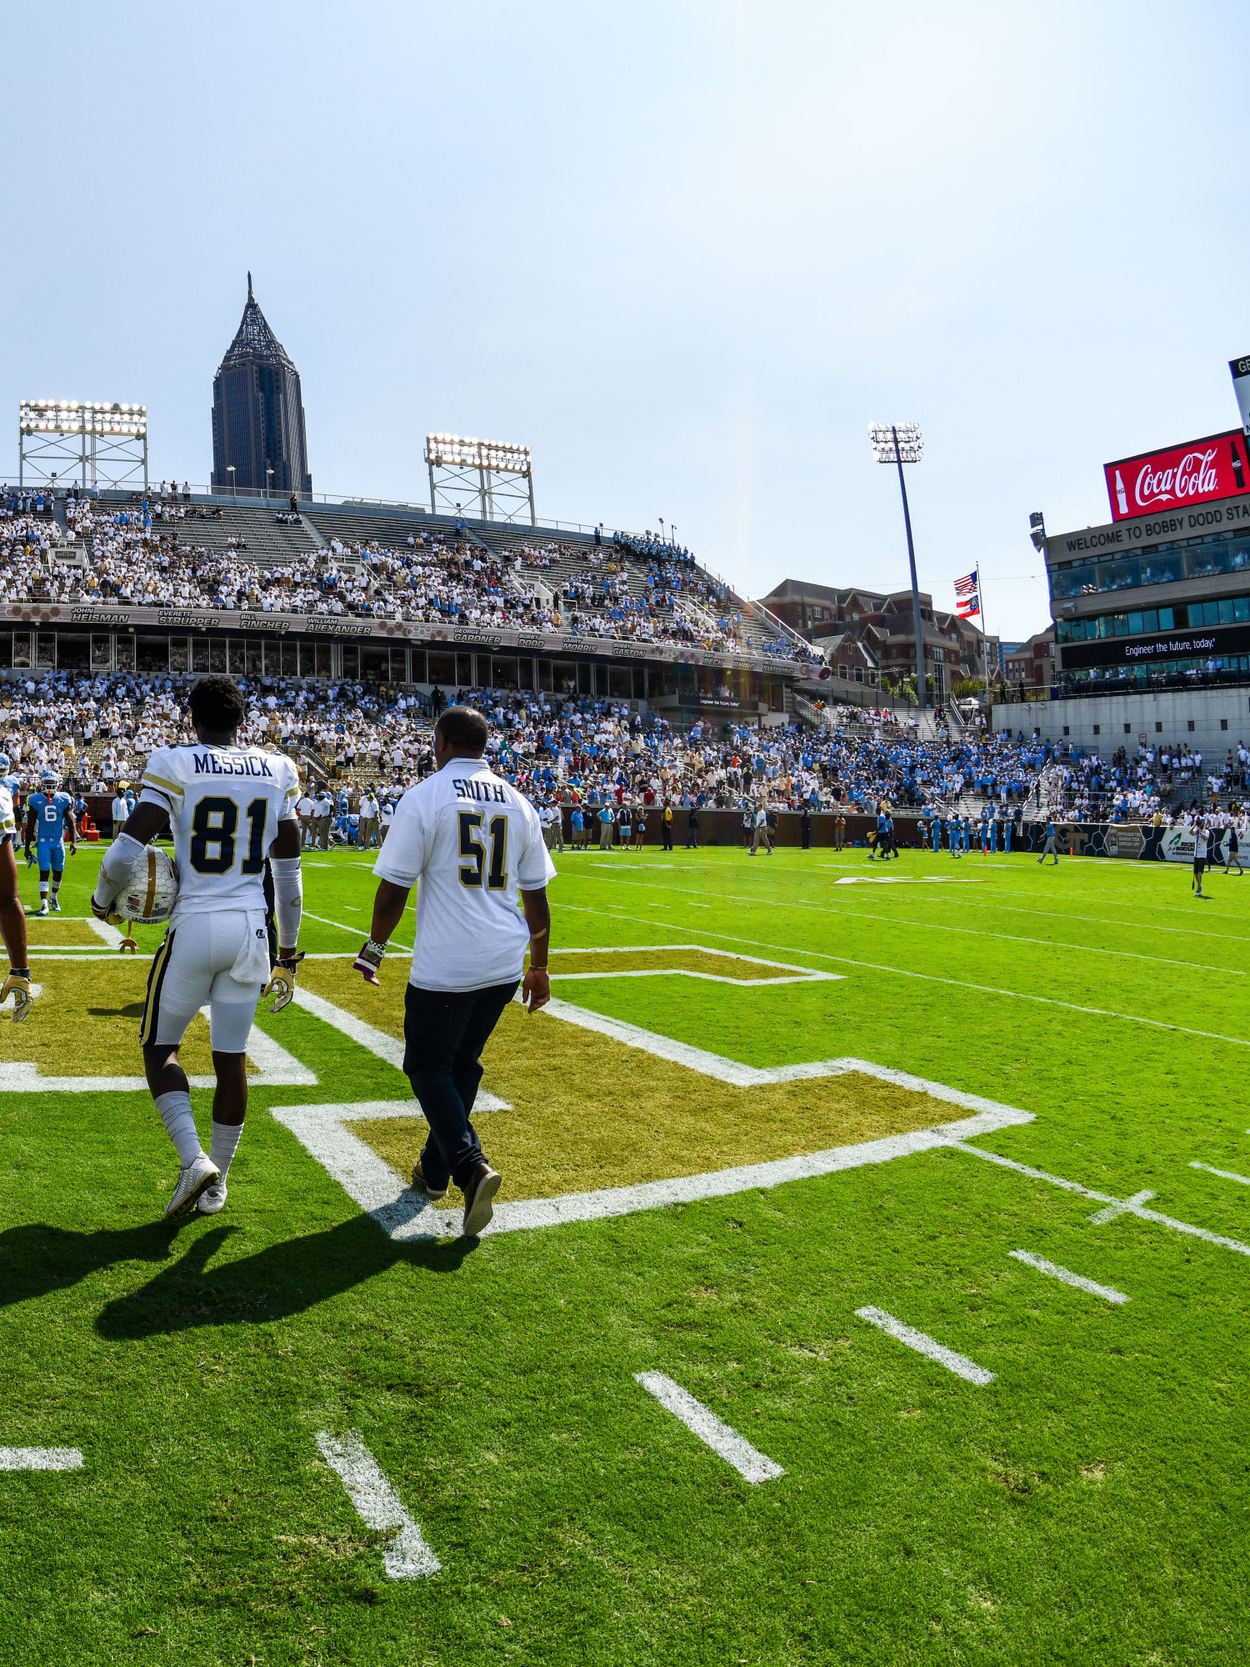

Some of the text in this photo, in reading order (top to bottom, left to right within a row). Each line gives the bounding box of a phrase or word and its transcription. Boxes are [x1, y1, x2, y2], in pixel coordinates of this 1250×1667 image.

[1135, 448, 1218, 506] Coca-Cola
[1066, 503, 1250, 552] WELCOME TO BOBBY DODD STA
[71, 613, 129, 623] HEISMAN
[158, 609, 192, 617] EVERETT
[158, 616, 220, 627] STRUPPER
[240, 620, 290, 630] FINCHER
[307, 617, 339, 625] WILLIAM
[305, 624, 372, 635] ALEXANDER
[454, 627, 480, 635] GEORGE
[453, 633, 501, 644] GARDNER
[517, 639, 545, 648] DODD
[562, 643, 597, 653] MORRIS
[612, 647, 646, 658] GASTON
[1126, 645, 1154, 656] Engineer
[1156, 643, 1167, 652] the
[1169, 641, 1191, 651] future,
[703, 658, 723, 666] BECK
[732, 661, 756, 671] RHINO
[193, 753, 273, 777] MESSICK
[452, 779, 506, 803] SMITH
[44, 805, 57, 821] 6
[190, 795, 268, 875] 81
[457, 810, 508, 891] 51
